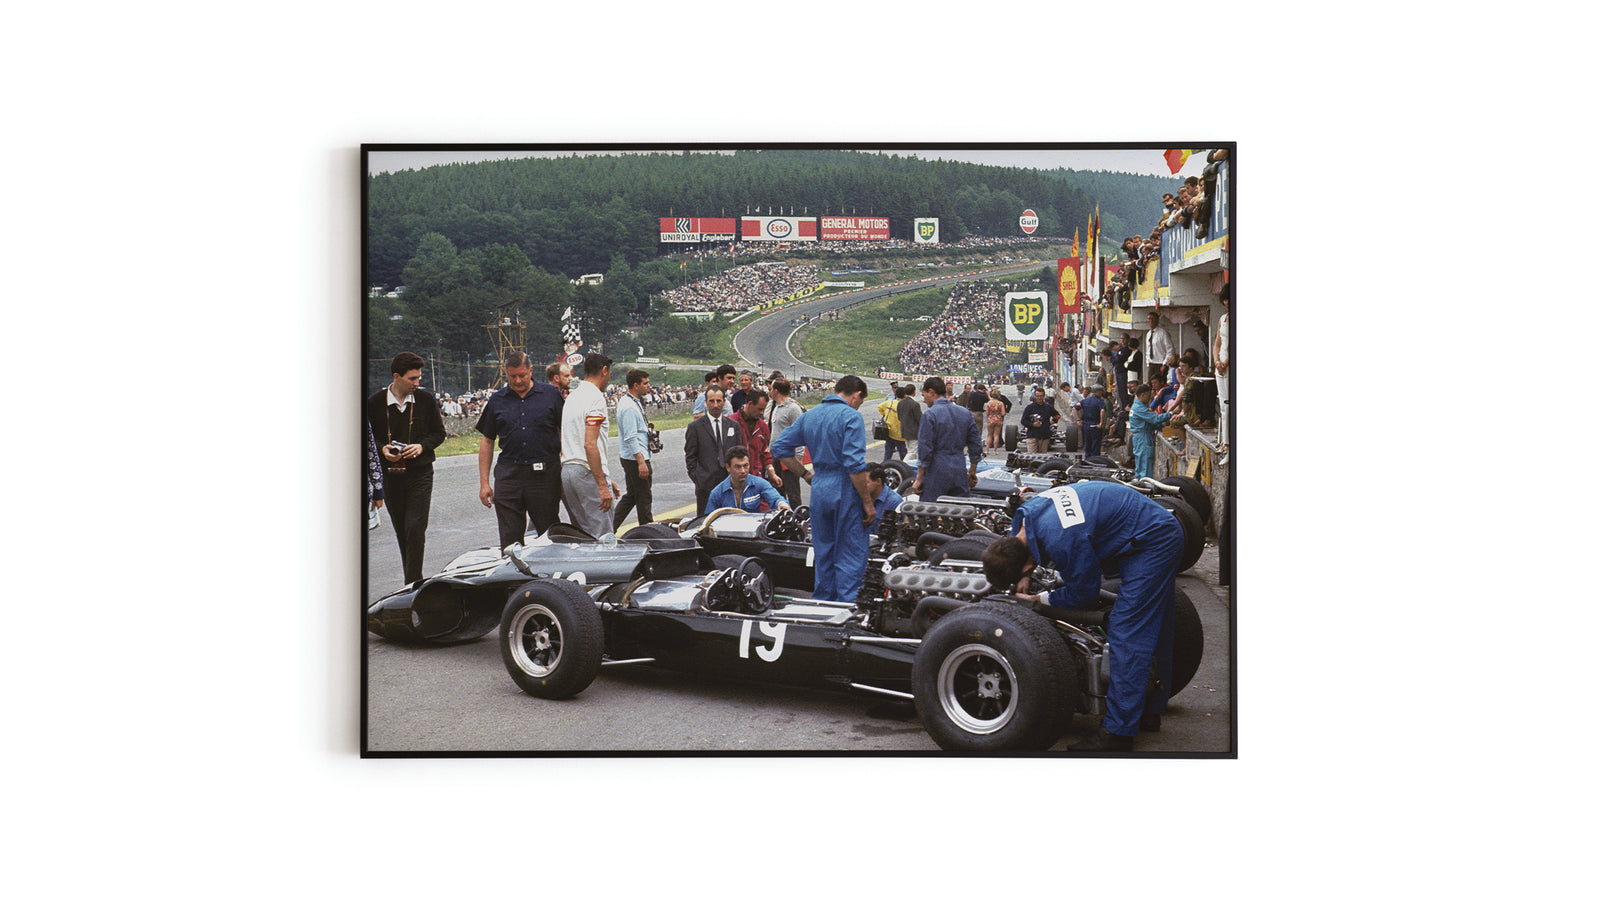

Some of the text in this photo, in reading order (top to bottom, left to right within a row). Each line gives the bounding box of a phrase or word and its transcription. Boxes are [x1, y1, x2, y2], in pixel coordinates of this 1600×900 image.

[822, 218, 889, 229] GENERAL MOTORS
[1020, 217, 1037, 225] Gulf
[920, 225, 935, 236] BP
[1062, 280, 1076, 291] SHELL
[1013, 303, 1041, 324] BP
[739, 619, 788, 662] 19
